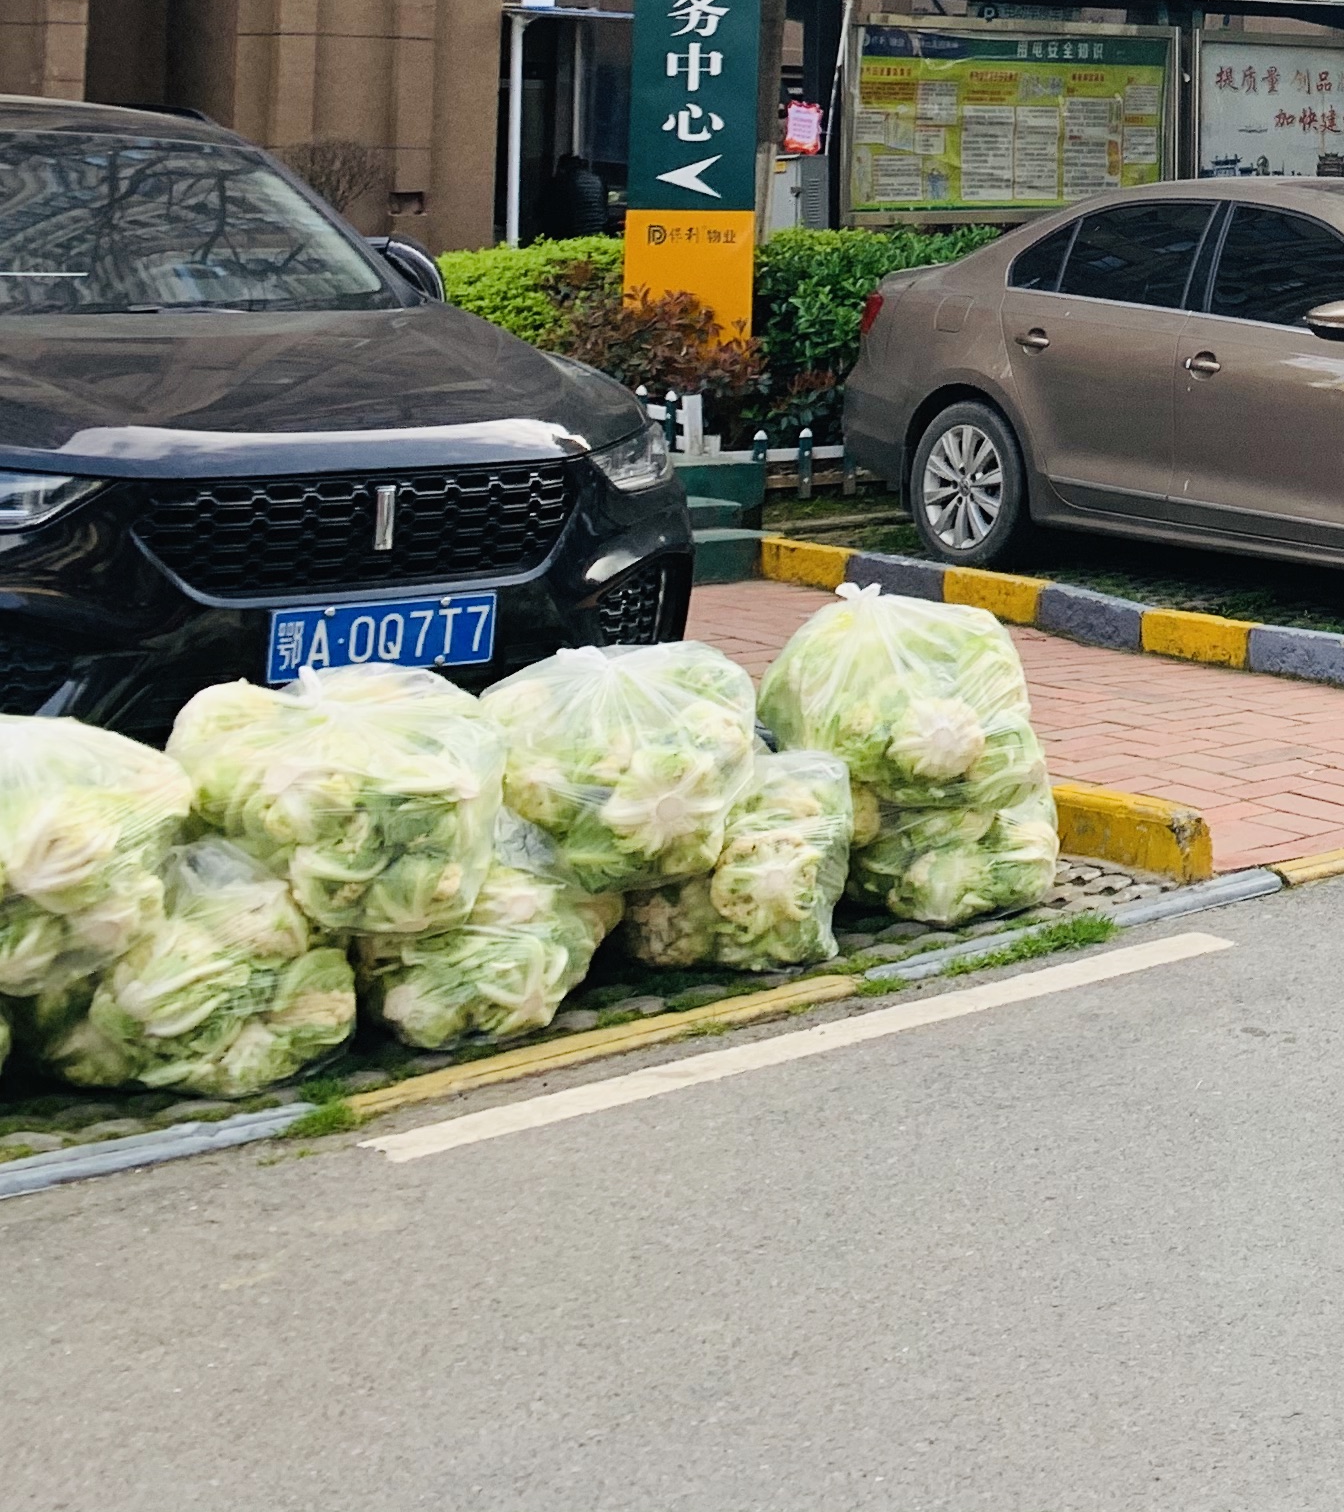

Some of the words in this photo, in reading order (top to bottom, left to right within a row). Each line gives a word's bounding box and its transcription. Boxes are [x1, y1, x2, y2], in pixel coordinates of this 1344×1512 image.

[1016, 41, 1104, 60] 用电安全知识
[1215, 66, 1281, 94] 提质量
